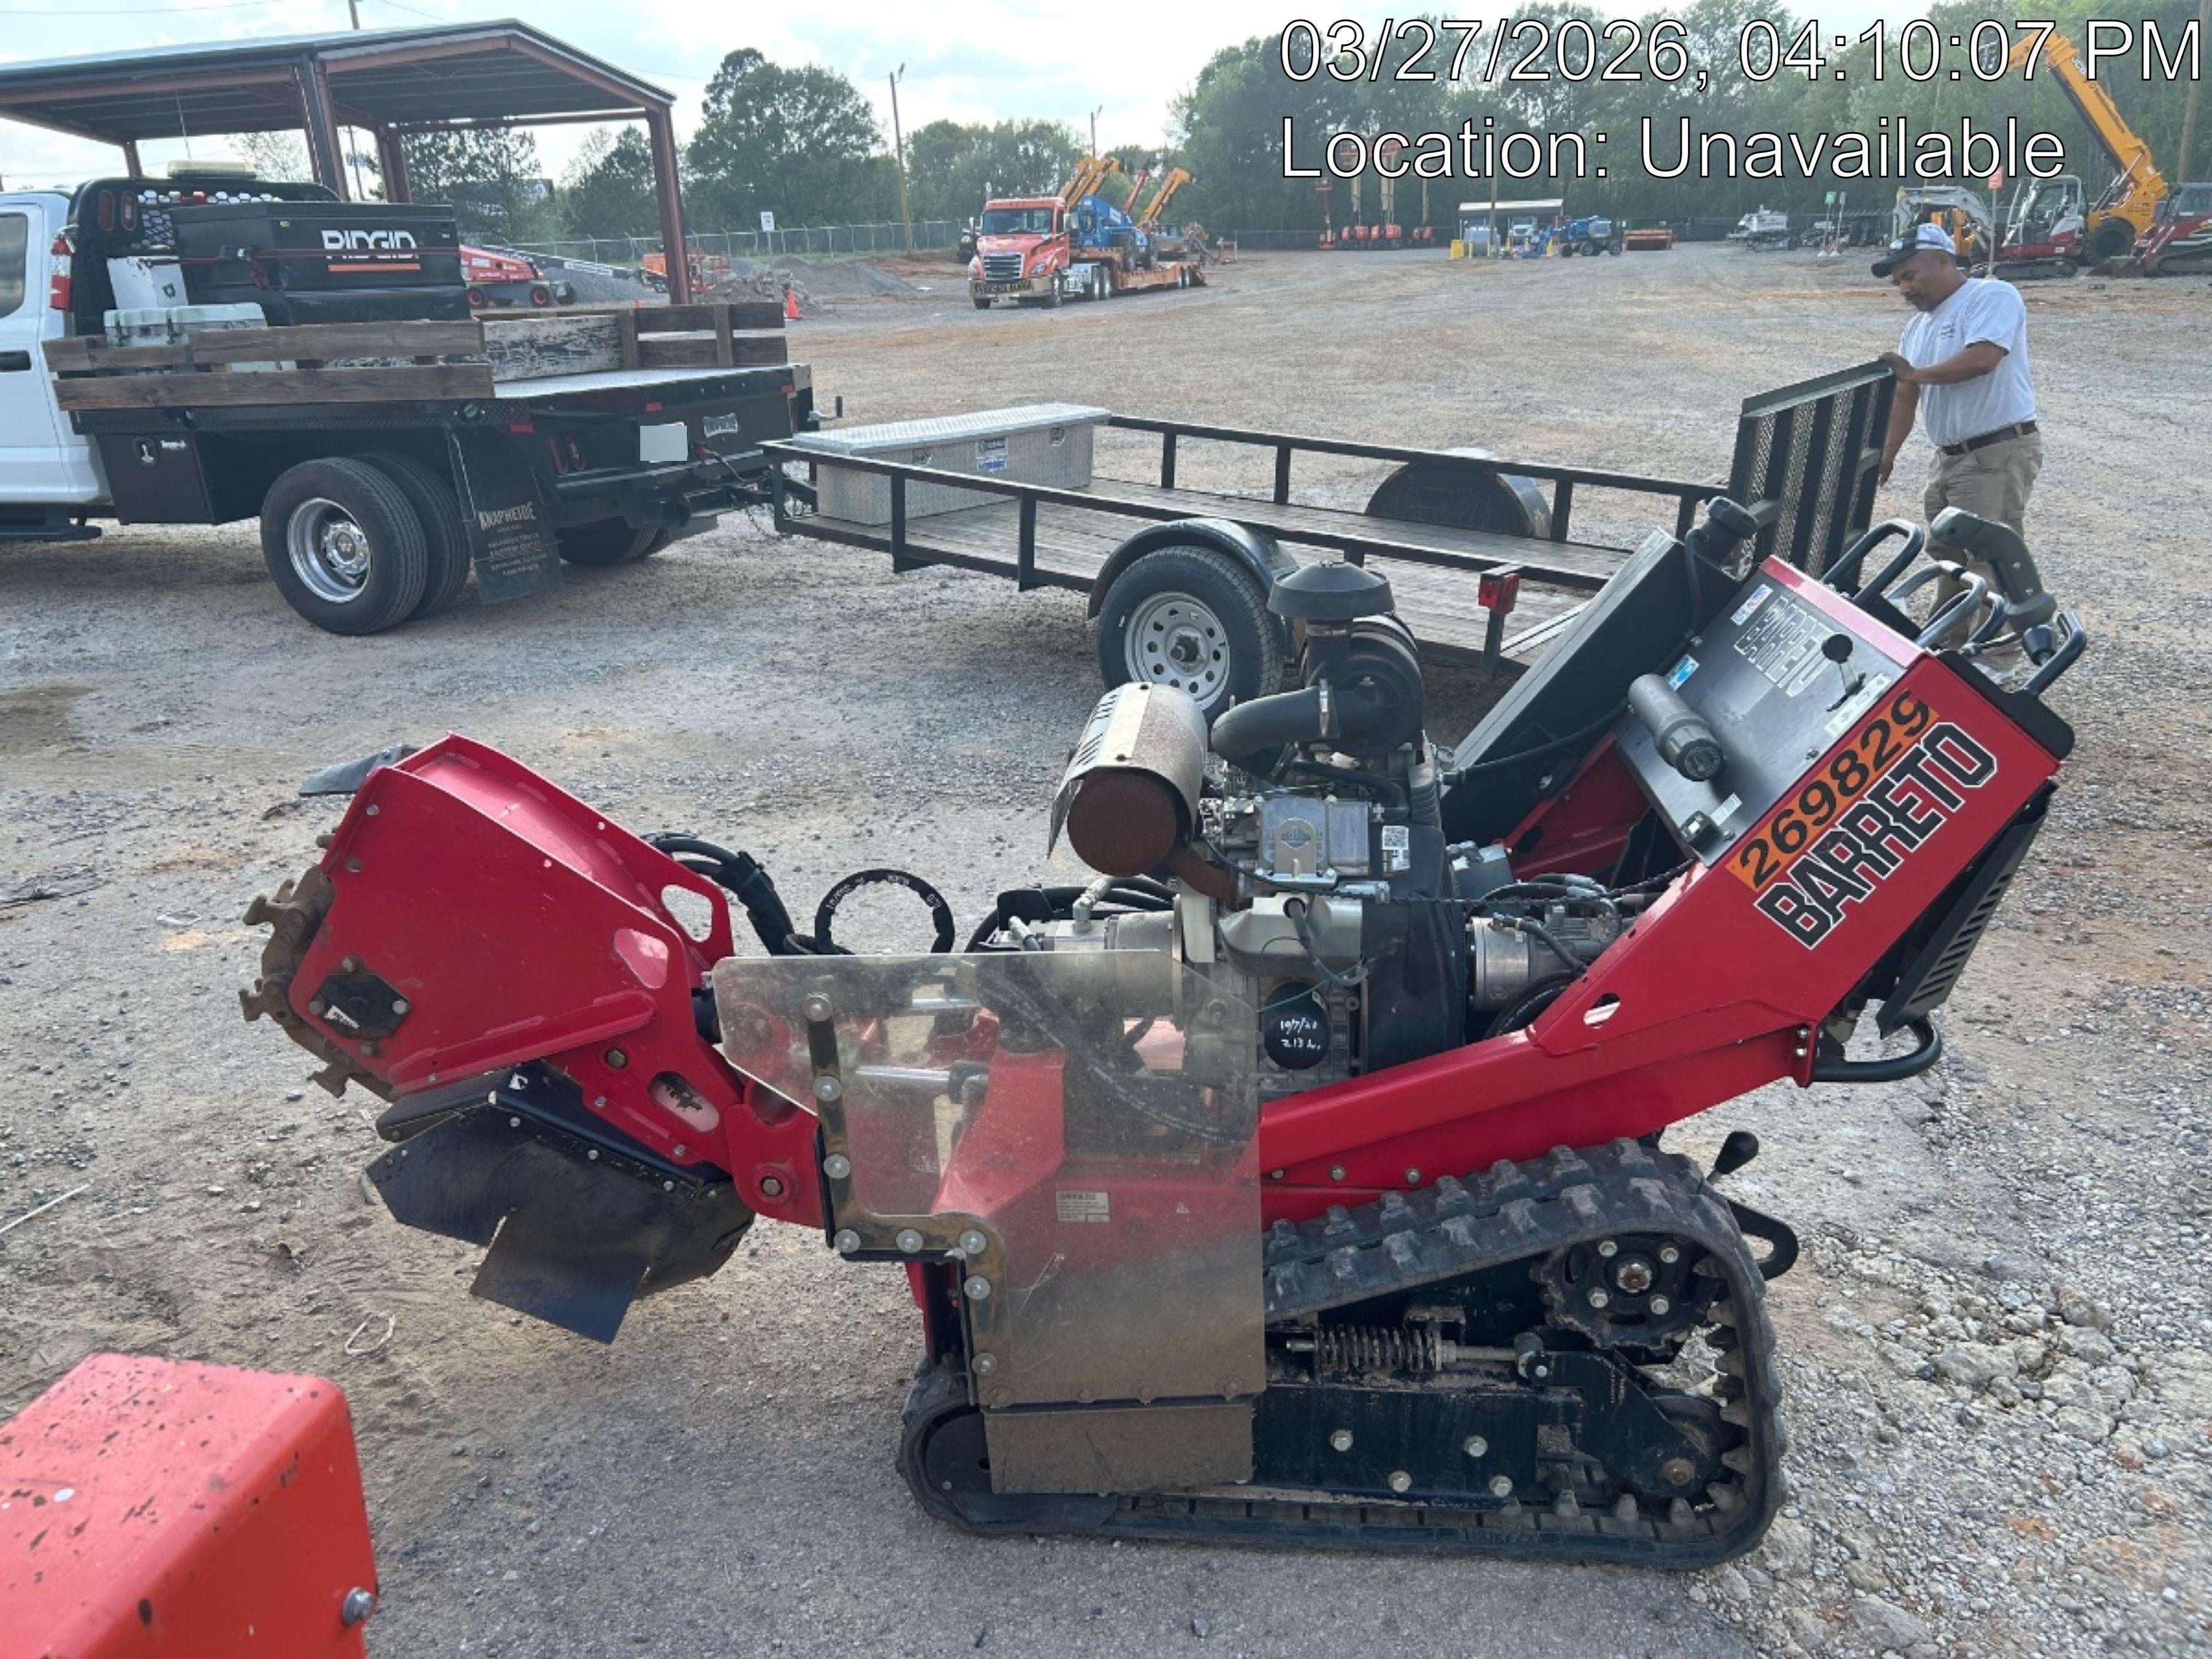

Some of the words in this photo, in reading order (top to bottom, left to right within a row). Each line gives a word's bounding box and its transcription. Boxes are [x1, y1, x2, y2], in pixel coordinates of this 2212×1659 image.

[321, 230, 419, 259] RIDGID
[1739, 688, 1930, 889] 269829
[1752, 721, 1998, 951] BARRETO
